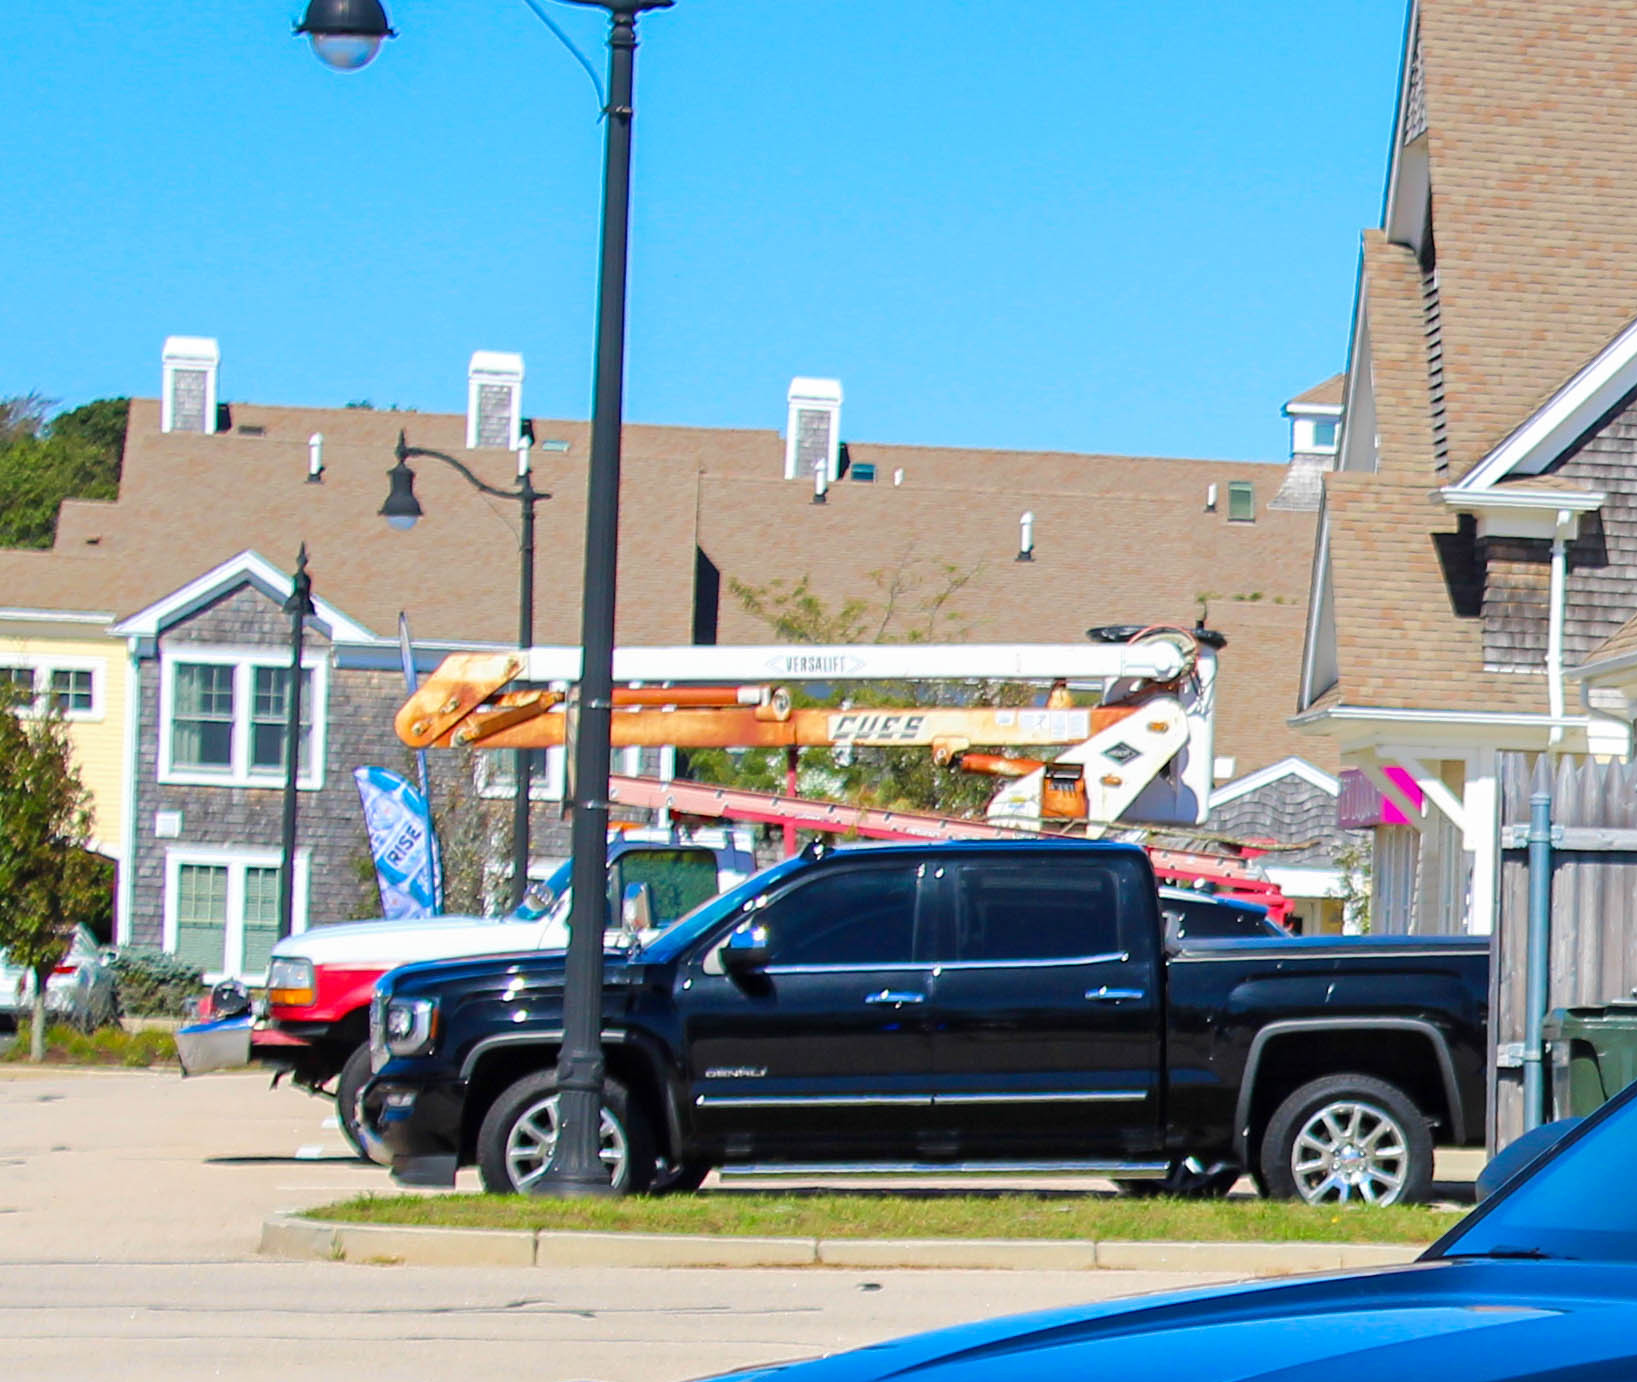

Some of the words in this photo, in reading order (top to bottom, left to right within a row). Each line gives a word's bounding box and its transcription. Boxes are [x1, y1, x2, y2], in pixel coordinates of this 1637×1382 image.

[785, 656, 847, 673] VERSALIFT
[832, 715, 926, 740] CUES
[386, 824, 423, 867] RISE
